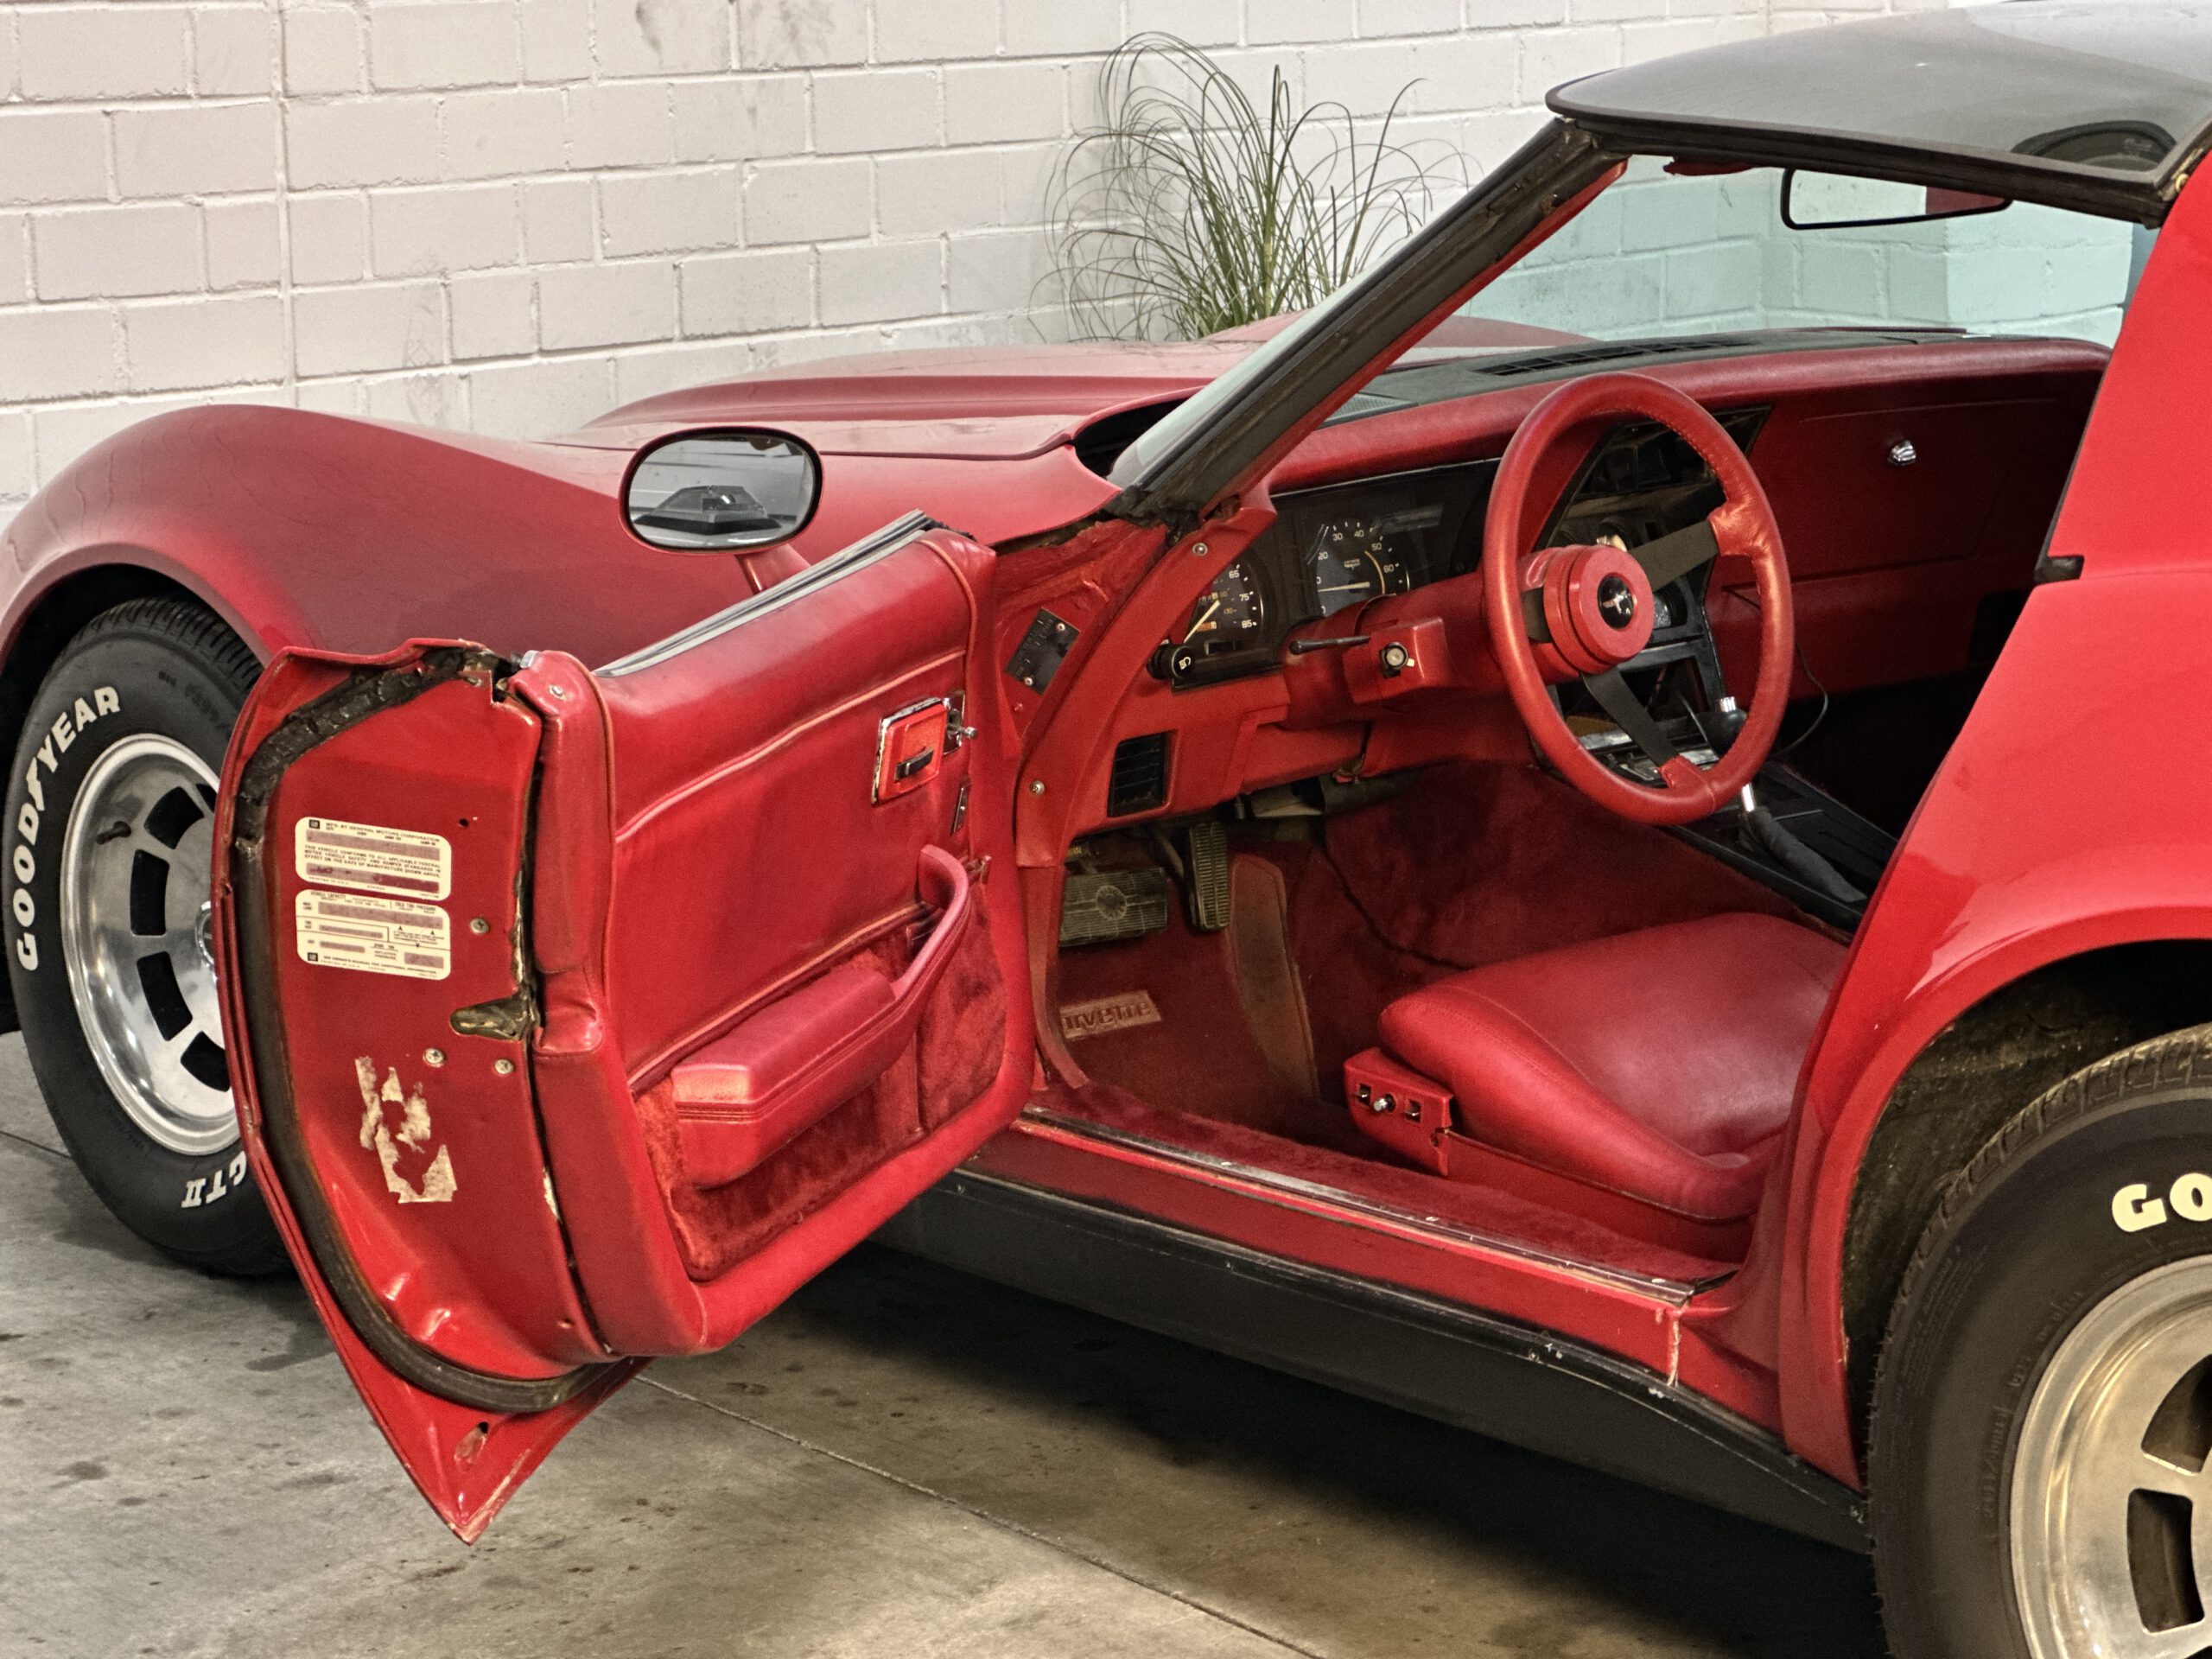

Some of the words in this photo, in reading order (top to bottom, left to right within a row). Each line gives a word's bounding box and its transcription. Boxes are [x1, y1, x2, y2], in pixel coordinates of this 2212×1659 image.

[1332, 532, 1343, 541] 30
[1371, 543, 1382, 551] 50
[1318, 551, 1328, 561] 20
[1229, 569, 1240, 579] 65
[1239, 593, 1249, 601] 75
[1242, 620, 1252, 629] 85
[12, 686, 121, 971] GOODYEAR
